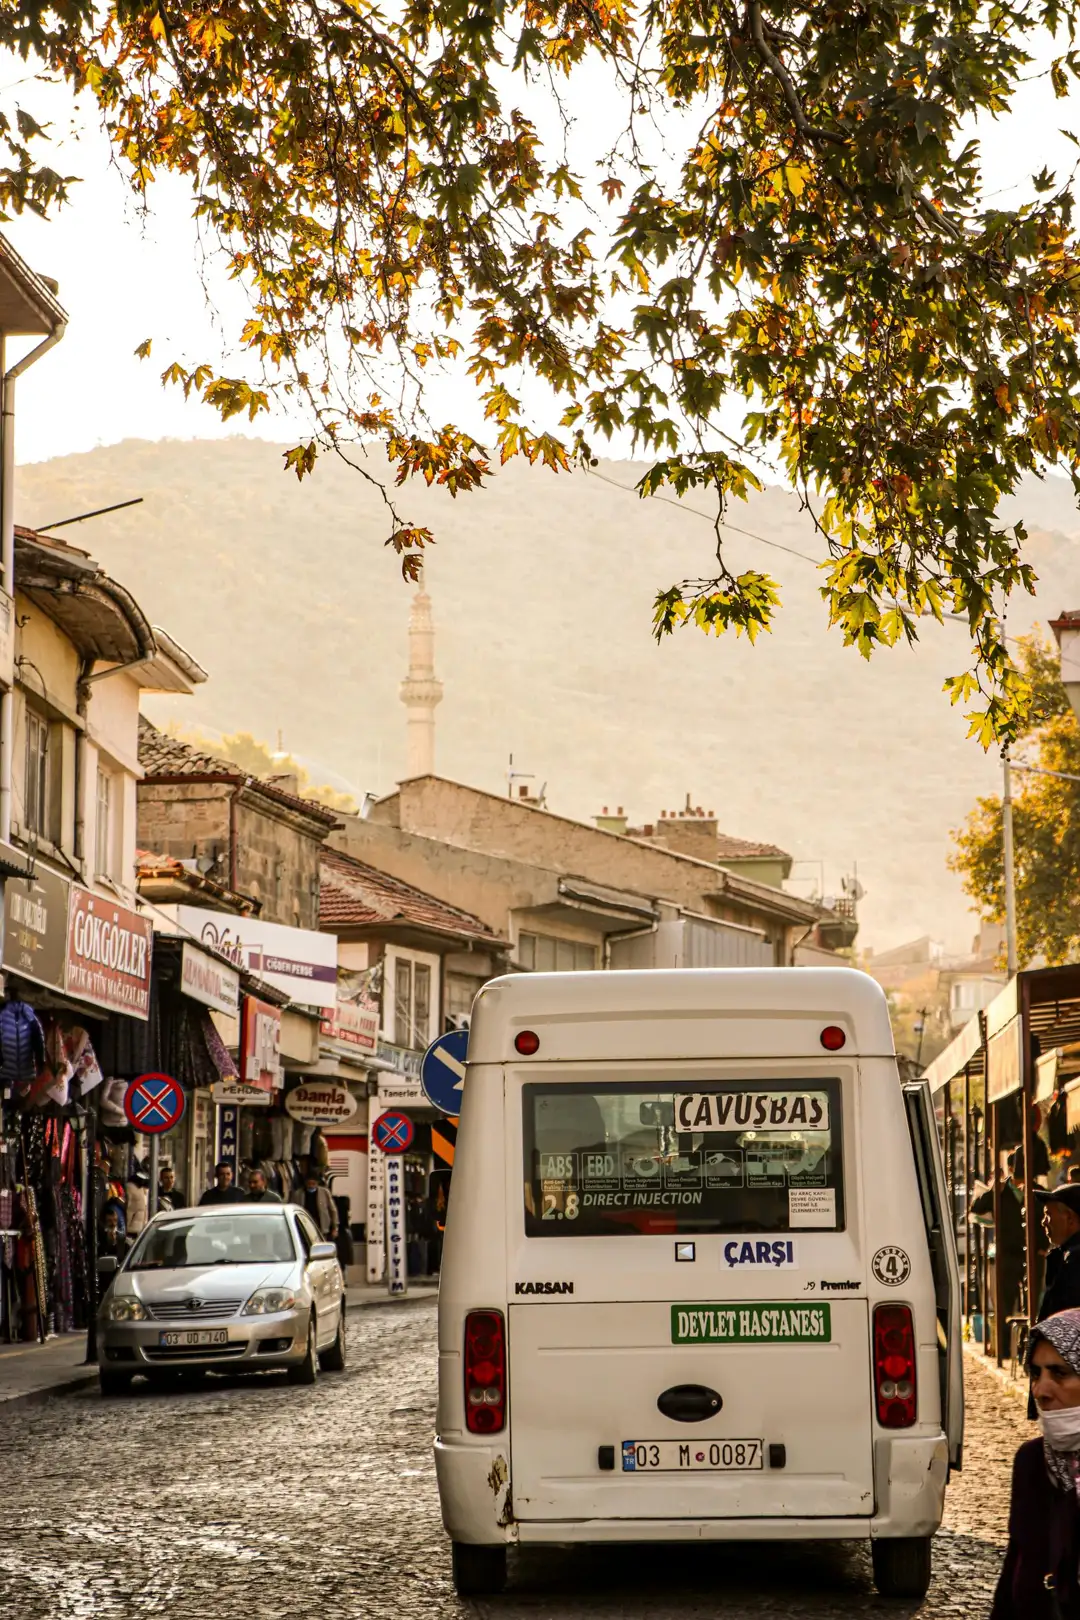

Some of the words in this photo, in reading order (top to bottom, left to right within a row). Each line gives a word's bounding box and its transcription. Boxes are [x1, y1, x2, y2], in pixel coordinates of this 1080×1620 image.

[74, 901, 147, 979] GÖKGÖZLER
[68, 960, 87, 987] İPLİK
[295, 1088, 345, 1106] Damla
[383, 1089, 418, 1098] Tanerler
[313, 1106, 351, 1116] perde
[679, 1094, 823, 1131] ÇAVUŞBAŞ
[546, 1155, 573, 1178] ABS
[587, 1155, 614, 1177] EBD
[541, 1194, 579, 1220] 2.8
[583, 1193, 631, 1206] DIRECT
[633, 1191, 703, 1206] INJECTION
[724, 1240, 794, 1268] ÇARŞI
[885, 1256, 899, 1276] 4
[514, 1282, 574, 1295] KARSAN
[802, 1280, 817, 1291] J9
[820, 1278, 862, 1291] Premier
[678, 1311, 737, 1338] DEVLET
[166, 1333, 179, 1345] 03
[207, 1331, 226, 1343] 140
[625, 1457, 634, 1465] TR
[636, 1445, 661, 1467] 03
[679, 1444, 690, 1467] M
[709, 1443, 758, 1467] 0087
